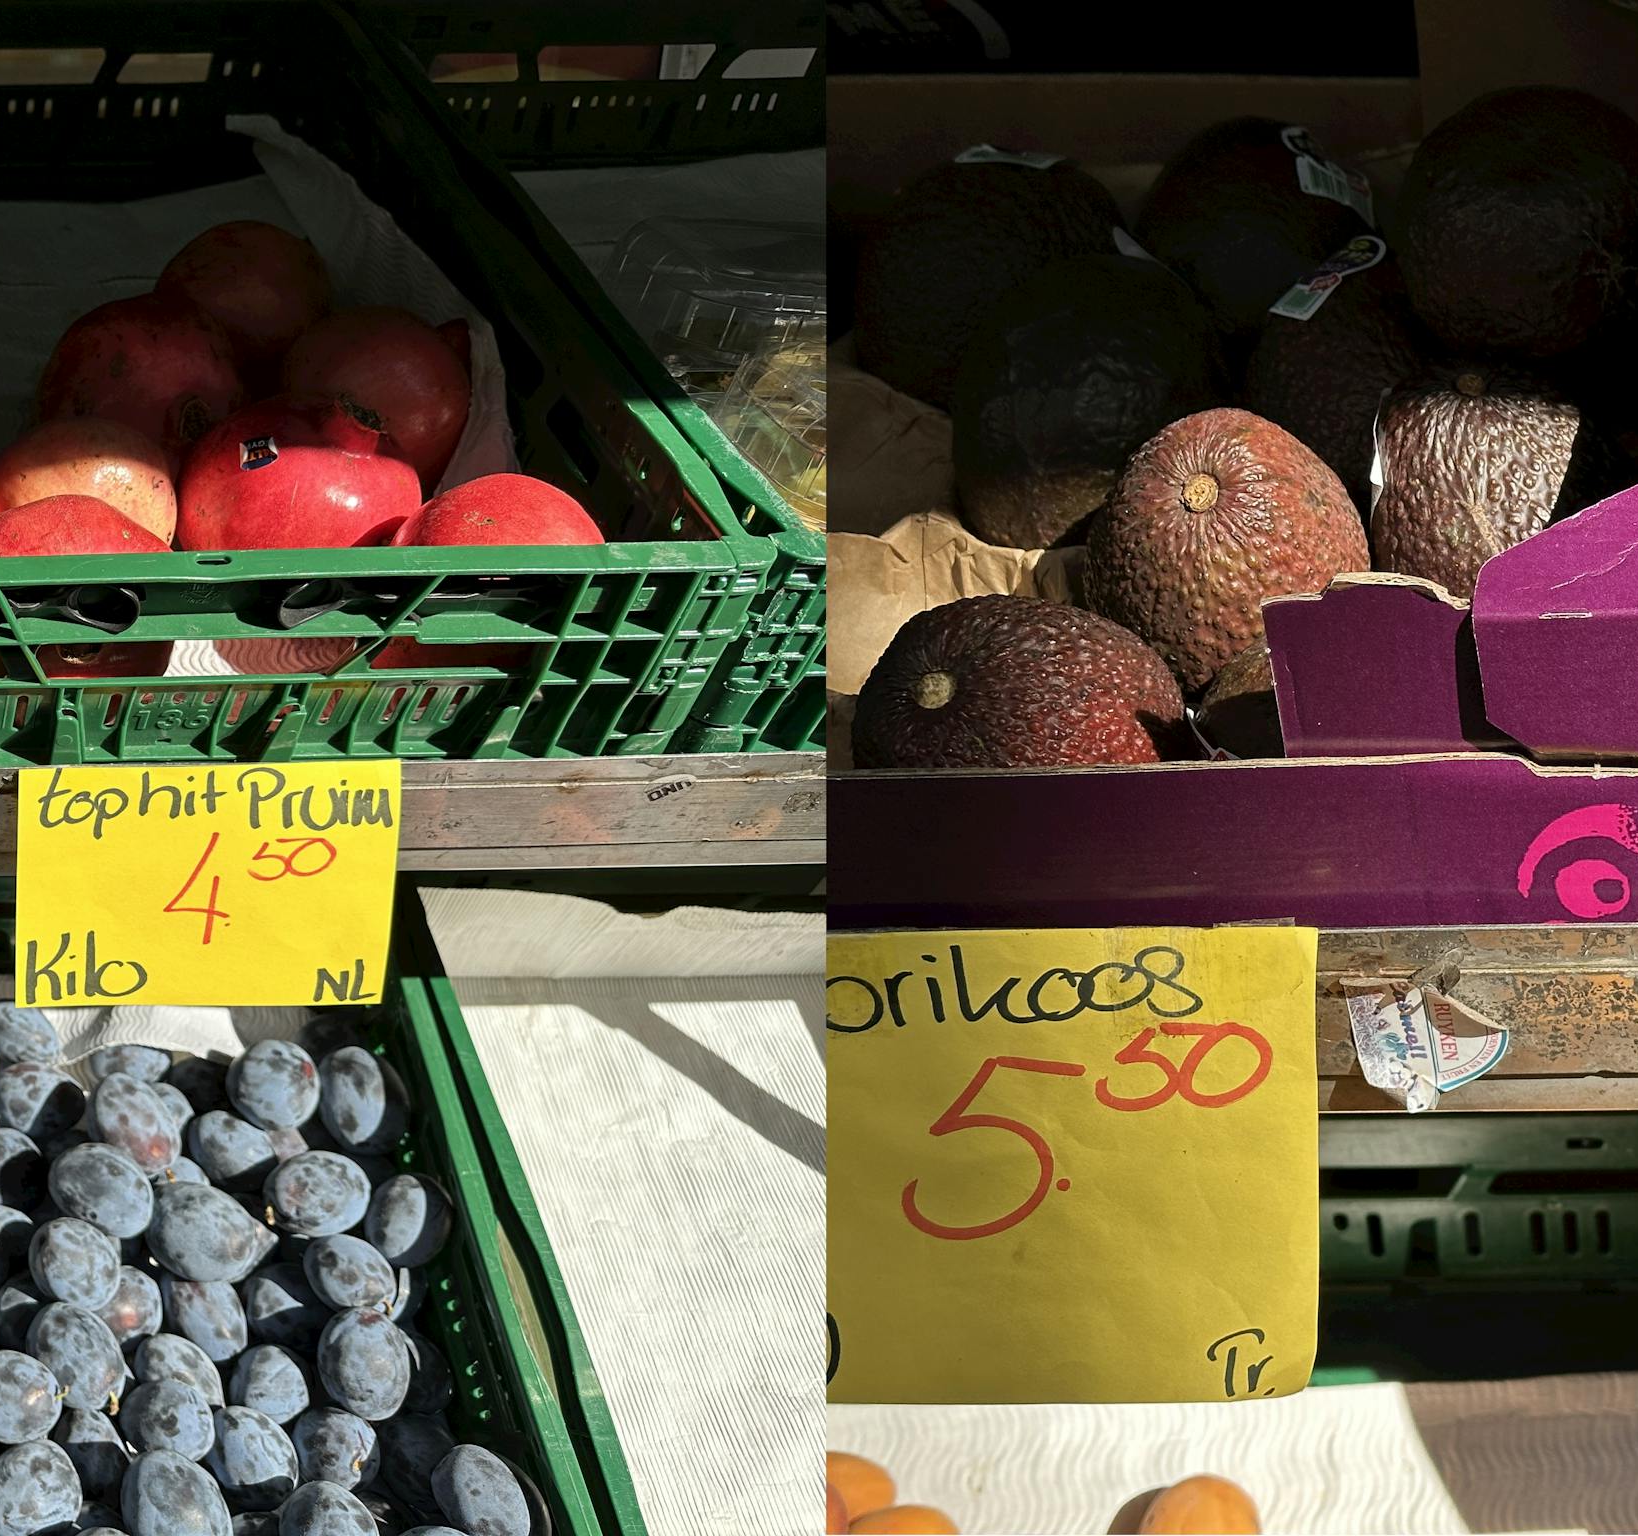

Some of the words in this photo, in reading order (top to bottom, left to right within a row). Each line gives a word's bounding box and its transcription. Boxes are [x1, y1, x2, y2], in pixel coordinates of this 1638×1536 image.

[235, 768, 394, 832] Pruim
[25, 930, 149, 1005] Kilo
[313, 959, 379, 1002] NL
[1433, 1002, 1459, 1063] RUYKEN
